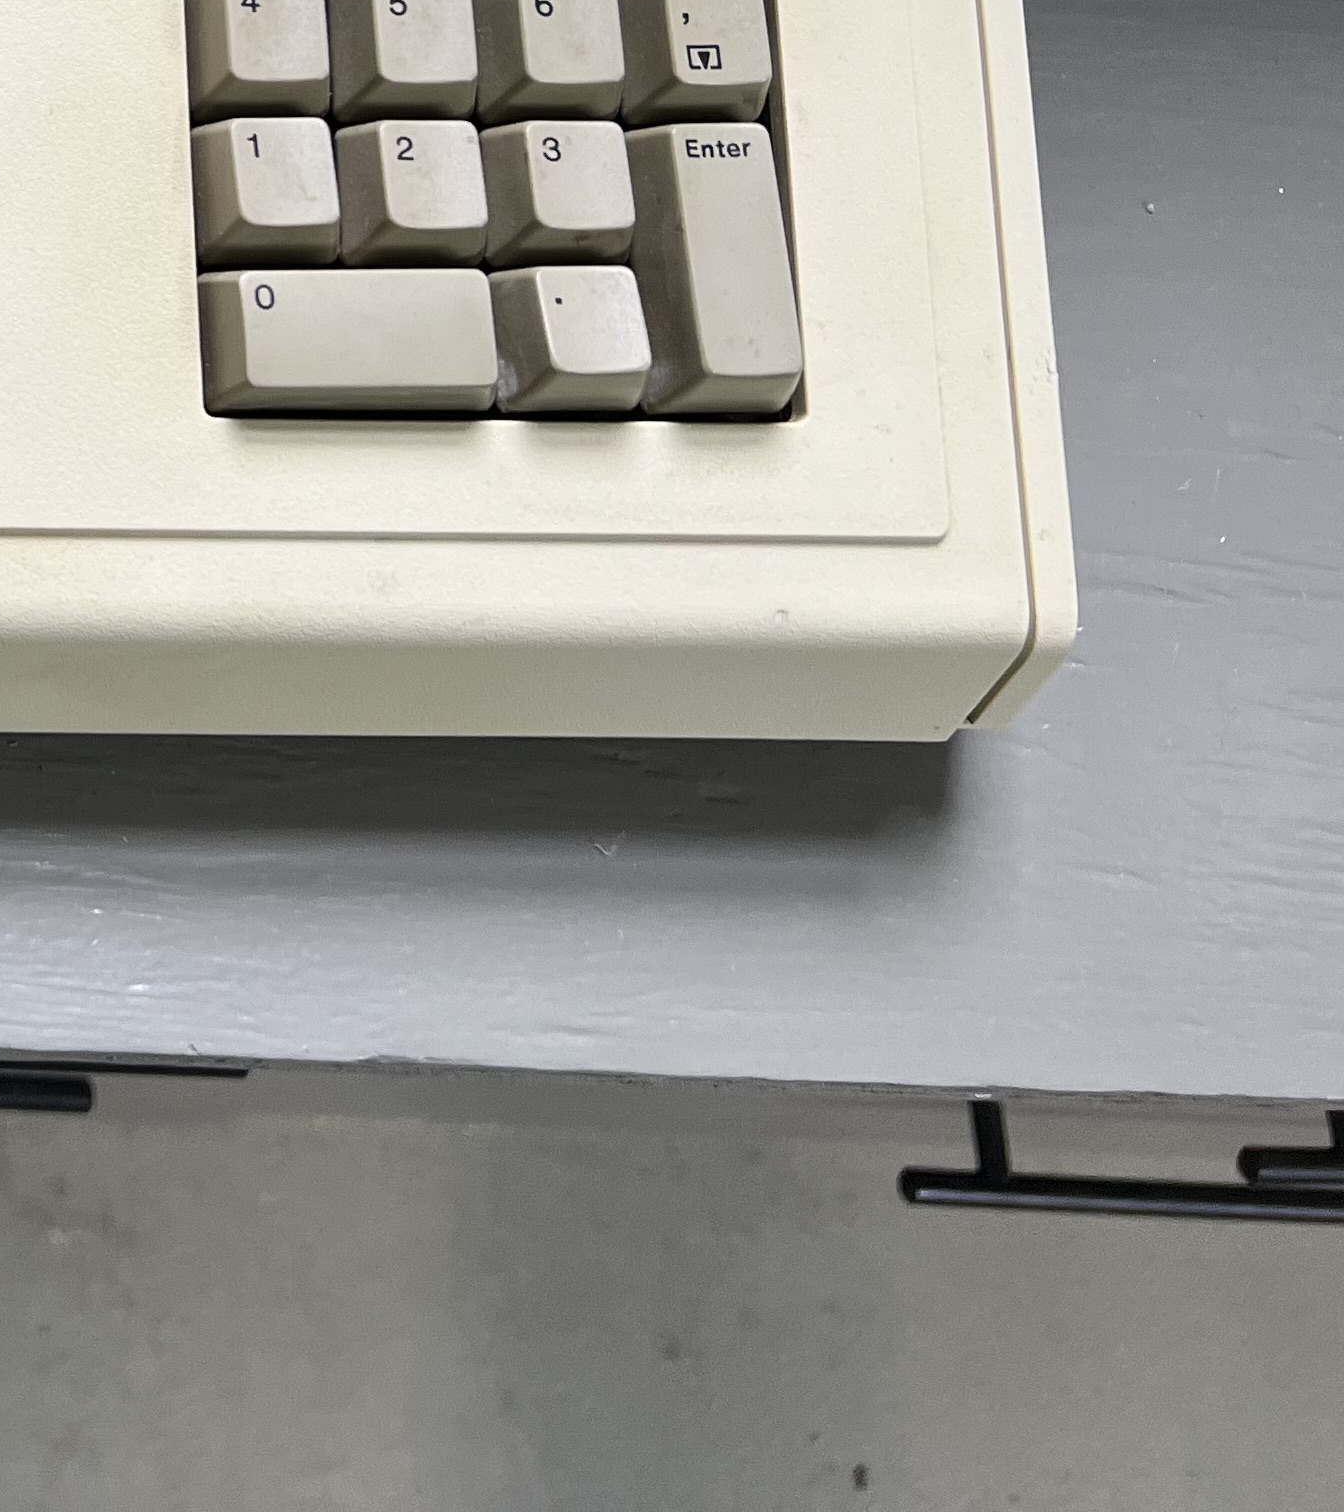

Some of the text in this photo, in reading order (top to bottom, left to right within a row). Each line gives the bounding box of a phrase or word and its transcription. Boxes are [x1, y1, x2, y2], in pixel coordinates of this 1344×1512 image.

[246, 133, 260, 158] 1
[396, 136, 415, 161] 2
[542, 136, 562, 162] 3
[685, 138, 751, 159] Enter
[254, 284, 275, 310] 0
